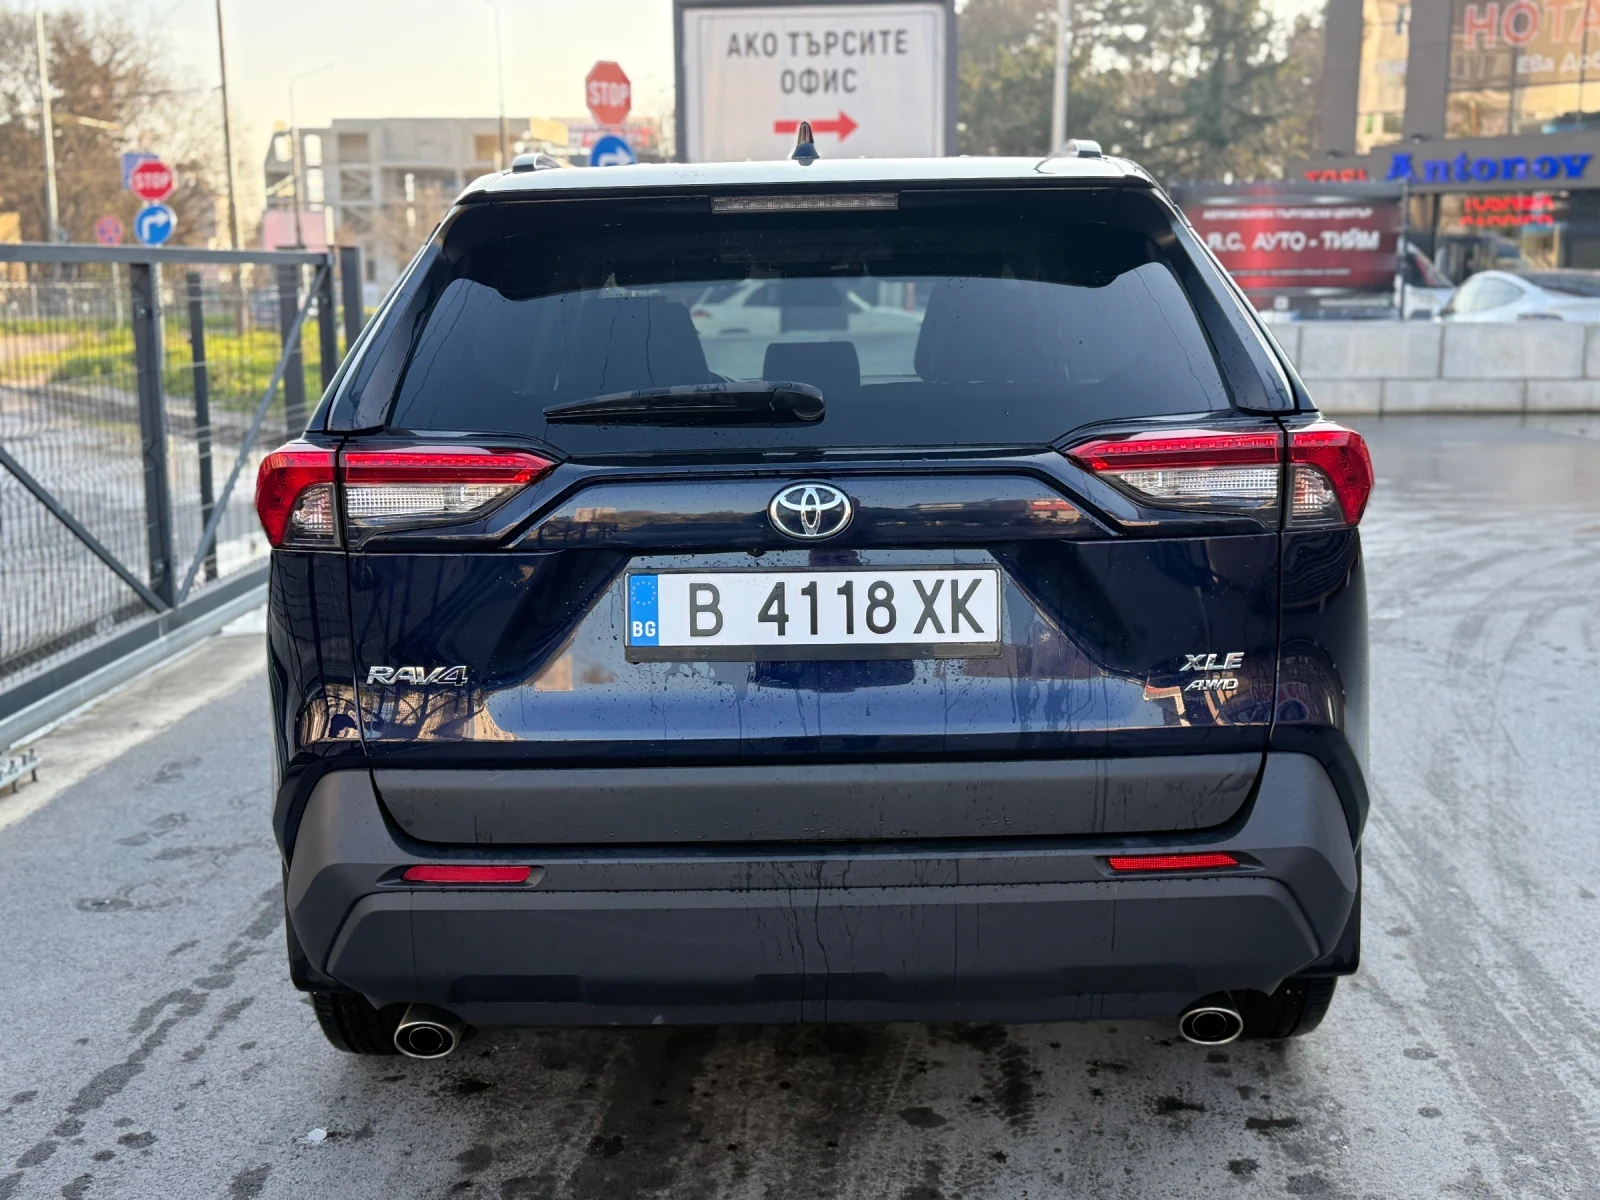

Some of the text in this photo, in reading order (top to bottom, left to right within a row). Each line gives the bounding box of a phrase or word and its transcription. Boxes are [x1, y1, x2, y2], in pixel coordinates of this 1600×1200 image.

[727, 29, 908, 58] АКО ТЪРСИТЕ
[780, 67, 858, 95] ОФИС
[588, 80, 629, 106] STOP
[1386, 151, 1594, 184] Antonov
[134, 171, 171, 190] STOP
[1251, 230, 1306, 252] АУТО
[688, 578, 985, 638] B 4118 XK
[631, 621, 656, 638] BG
[1179, 652, 1245, 672] XLE
[366, 665, 468, 687] RAV4
[1184, 678, 1239, 692] AWD
